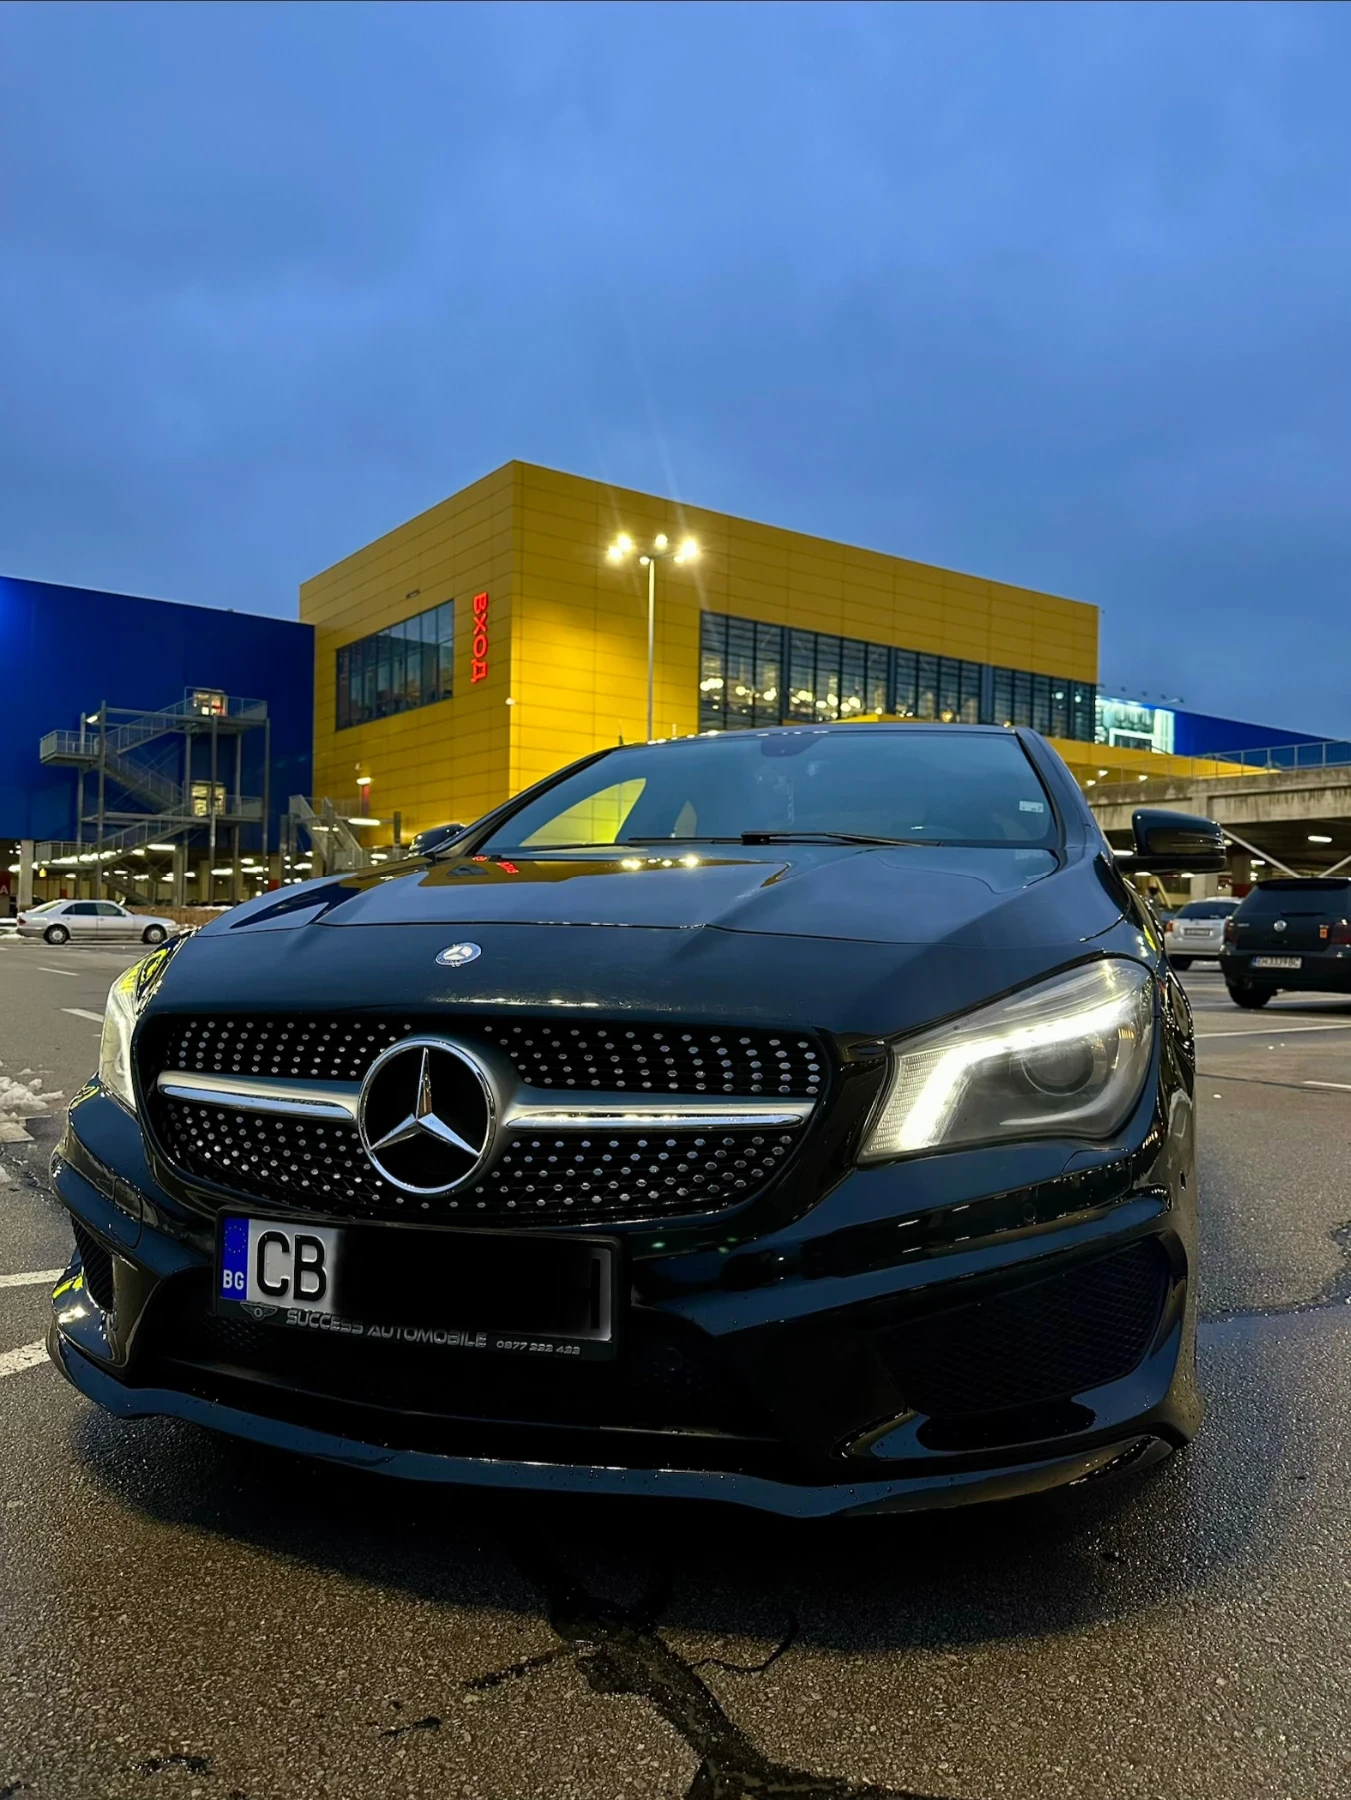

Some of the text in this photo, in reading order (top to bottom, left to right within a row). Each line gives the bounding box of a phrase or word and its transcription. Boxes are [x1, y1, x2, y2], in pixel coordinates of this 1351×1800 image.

[471, 592, 488, 684] ВХОД
[223, 1269, 244, 1290] BG
[257, 1230, 327, 1301] CB
[286, 1310, 364, 1334] SUCCESS
[367, 1324, 487, 1348] AUTOMOBILE
